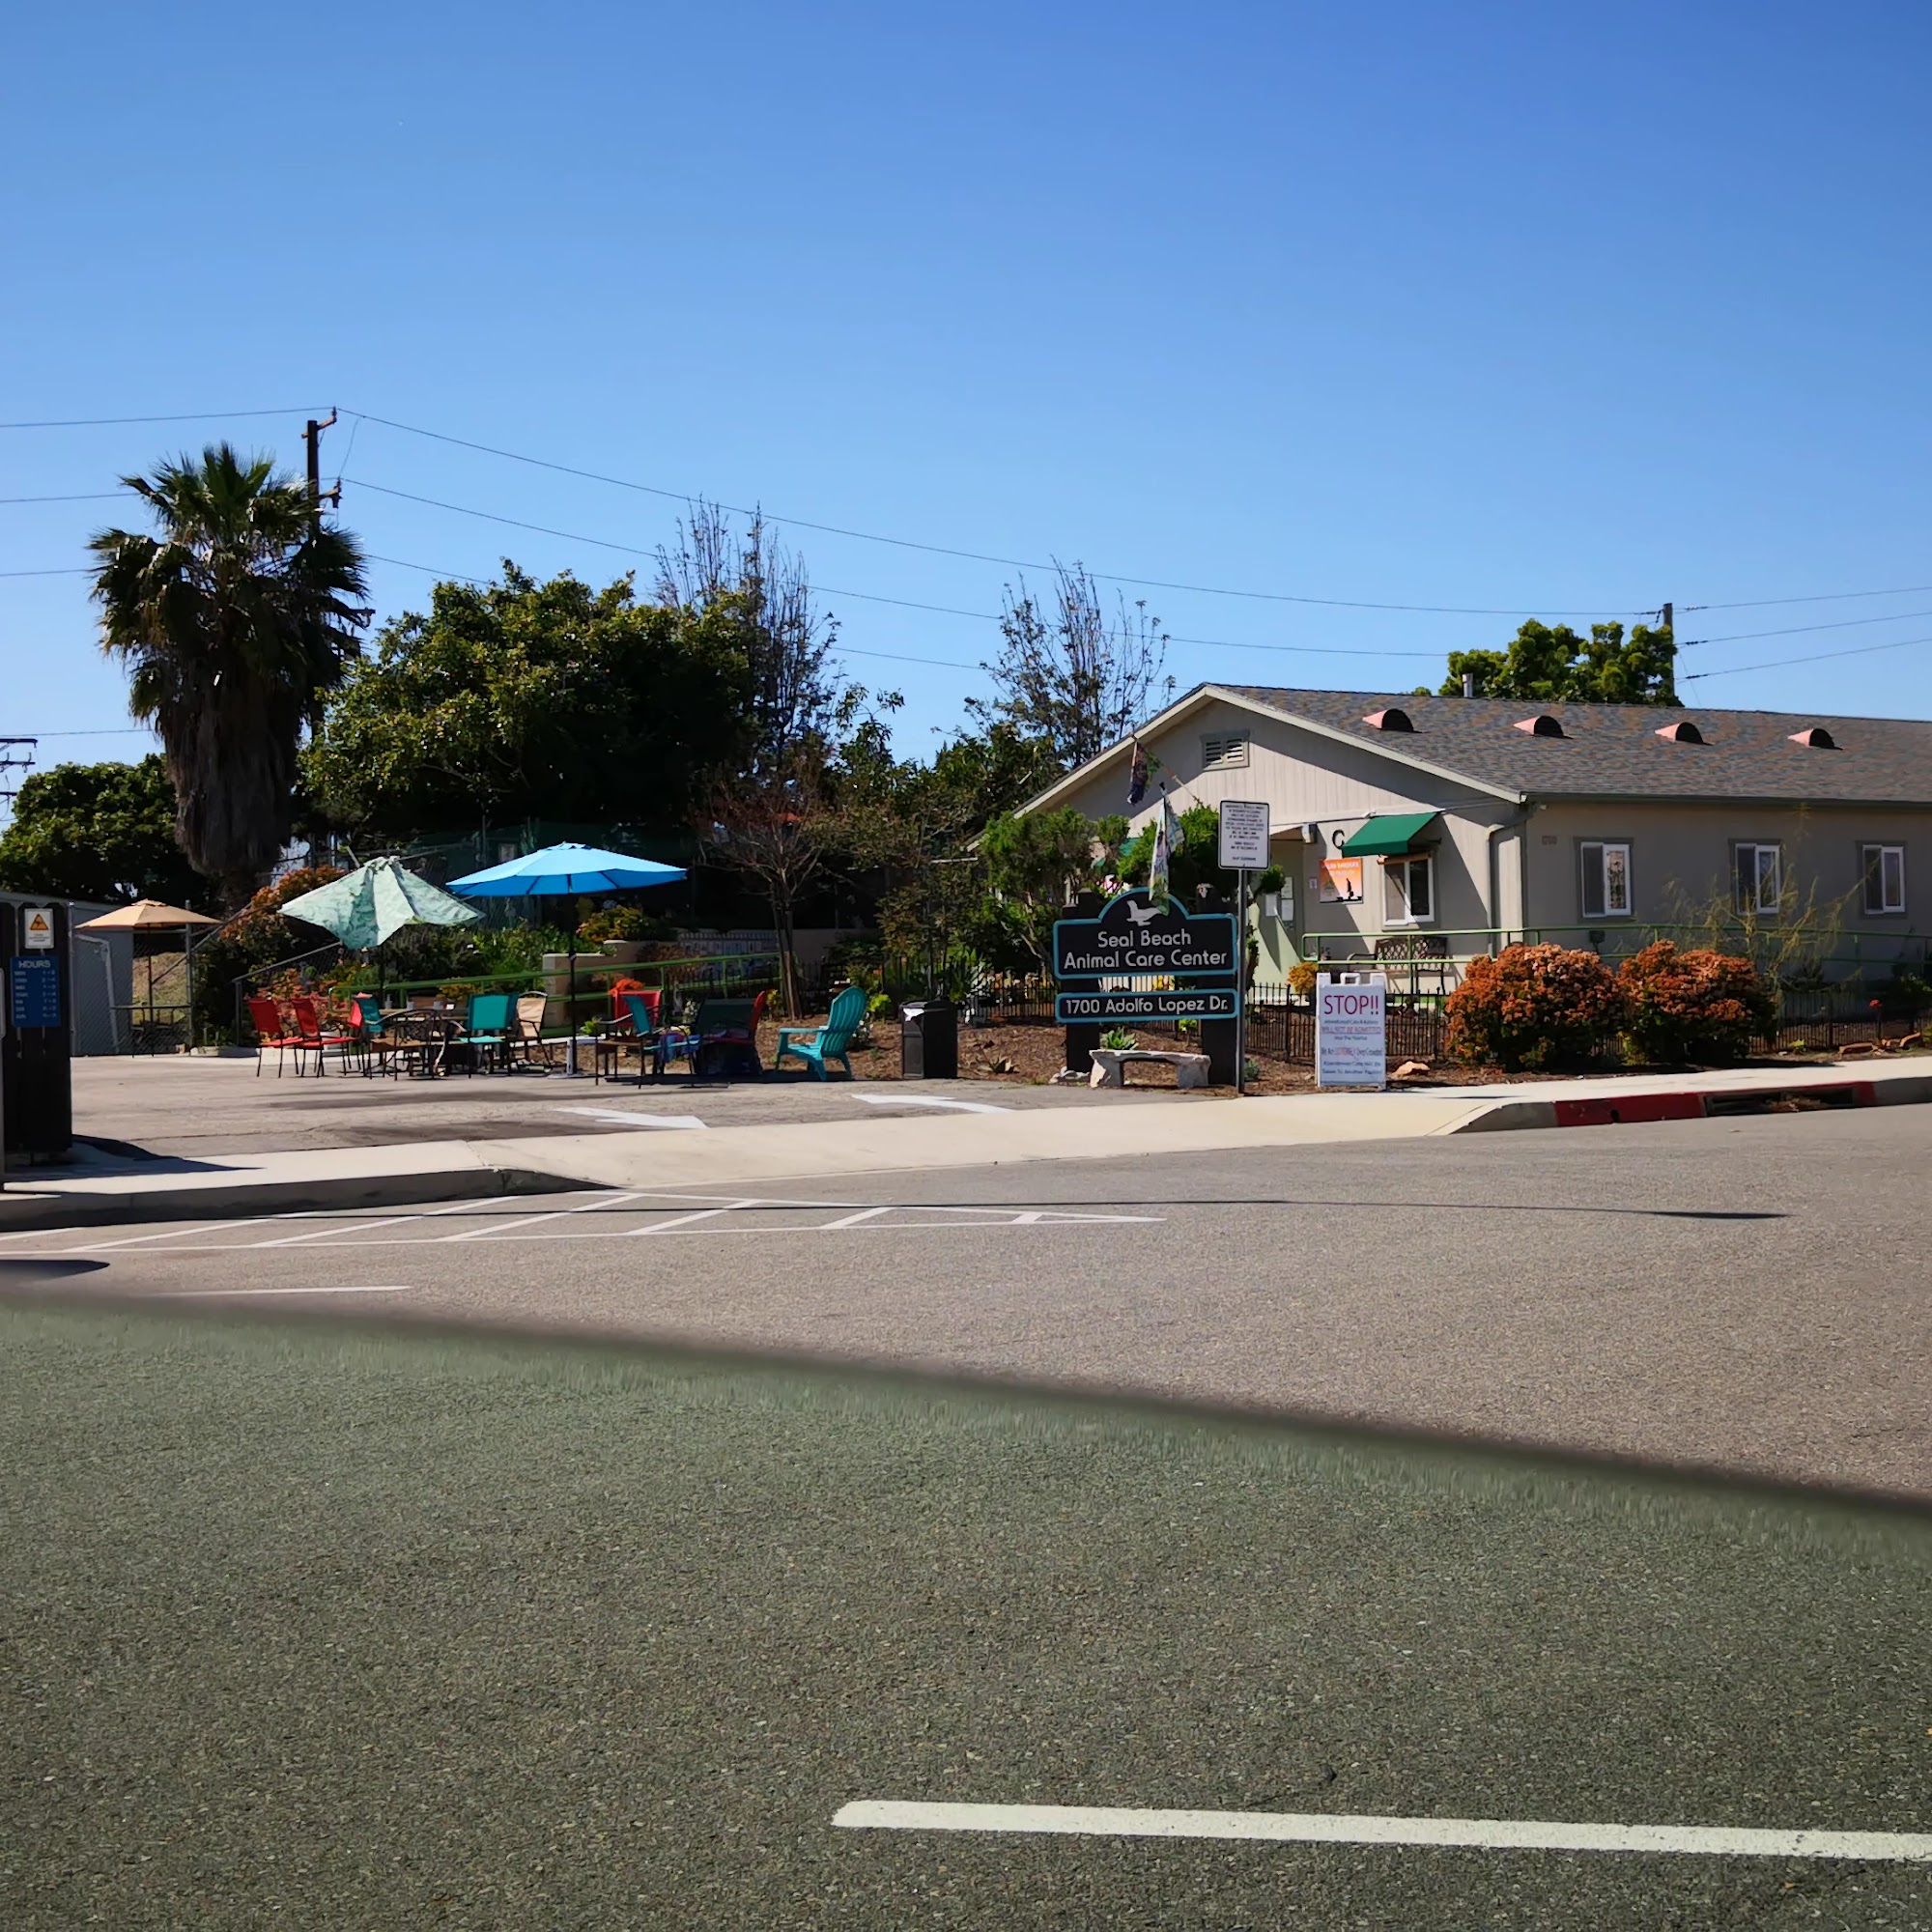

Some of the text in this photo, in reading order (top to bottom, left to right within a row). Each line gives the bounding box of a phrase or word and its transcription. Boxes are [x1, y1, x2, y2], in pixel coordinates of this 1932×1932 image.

[1097, 928, 1191, 948] Seal Beach
[1064, 949, 1227, 969] Animal Care Center
[1065, 995, 1228, 1014] 1700 Adolfo Lopez Dr.
[1324, 995, 1378, 1014] STOP!!
